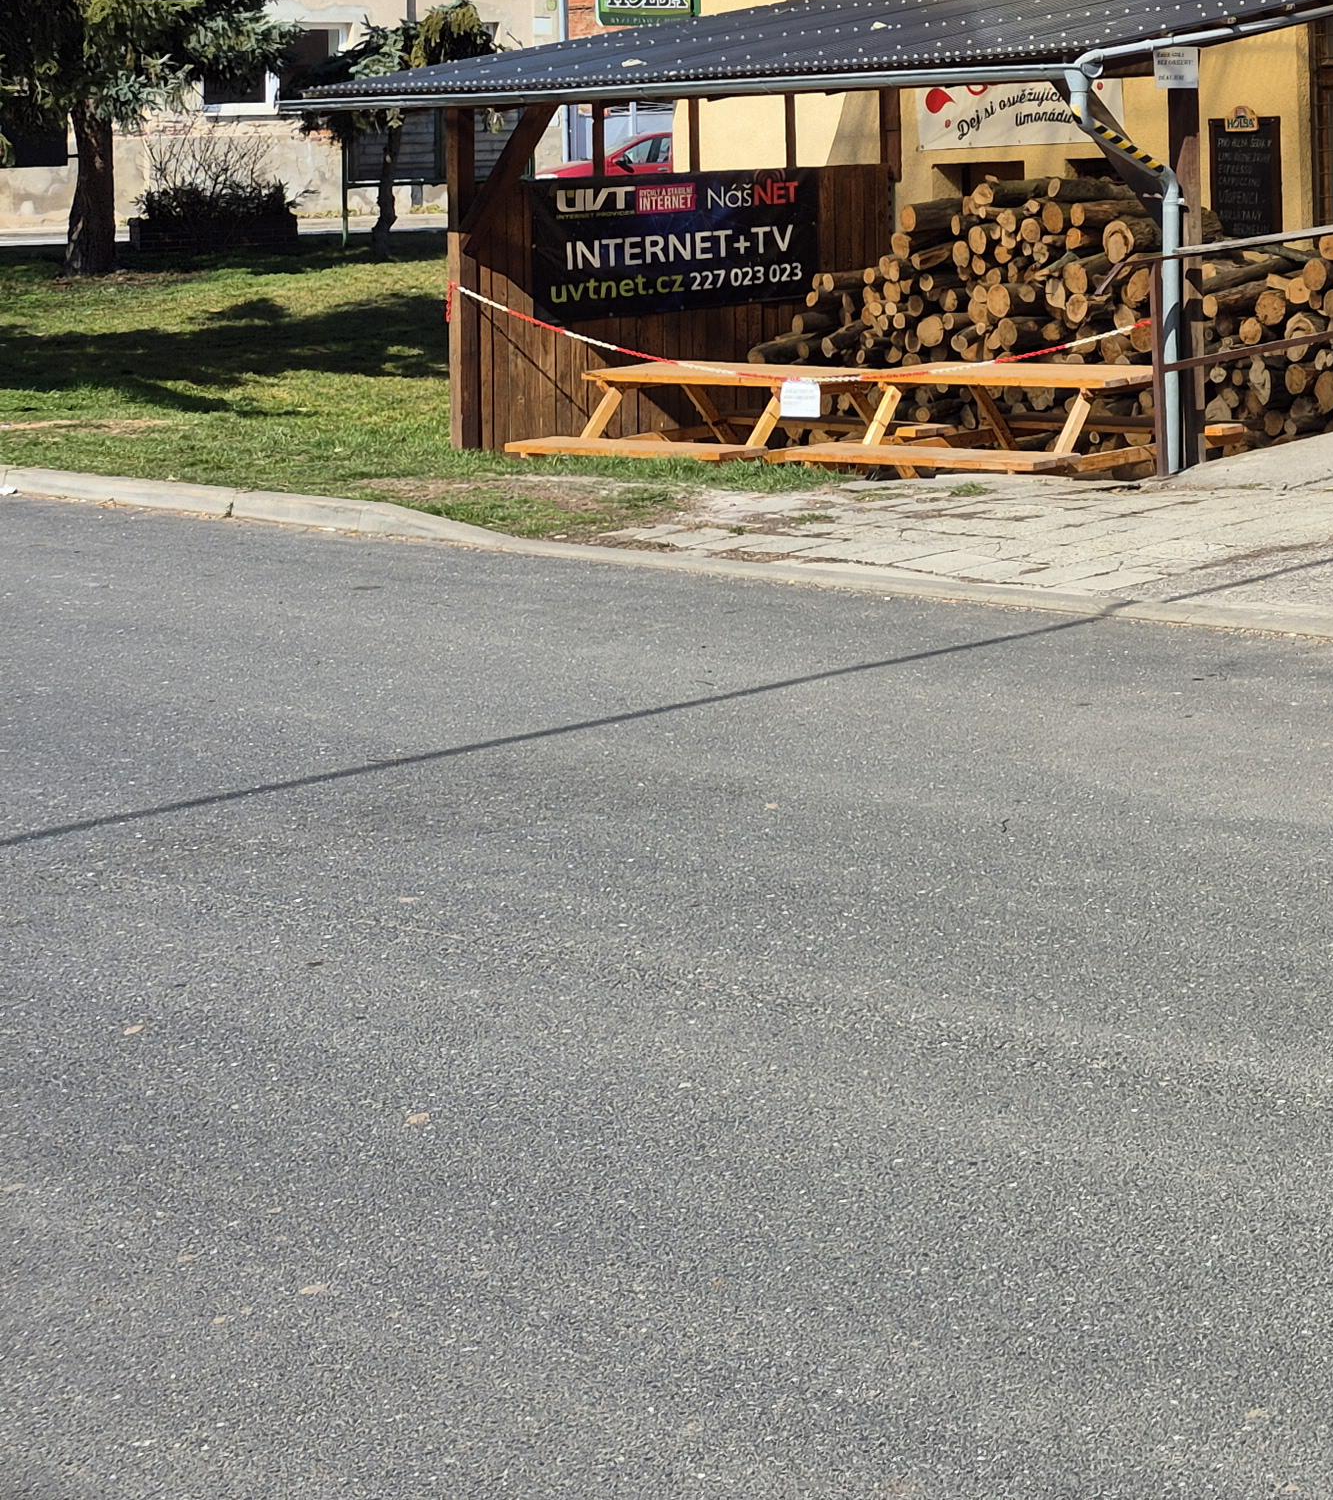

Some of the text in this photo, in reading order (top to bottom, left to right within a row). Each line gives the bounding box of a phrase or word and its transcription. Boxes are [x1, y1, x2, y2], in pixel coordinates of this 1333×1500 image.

[957, 110, 982, 140] Dej
[984, 101, 996, 119] si
[1015, 108, 1073, 127] limonádu
[557, 186, 635, 212] UVT
[639, 194, 692, 211] INTERNET
[566, 224, 793, 270] INTERNET+TV
[550, 263, 802, 304] uvtnet.cz 227 023 023
